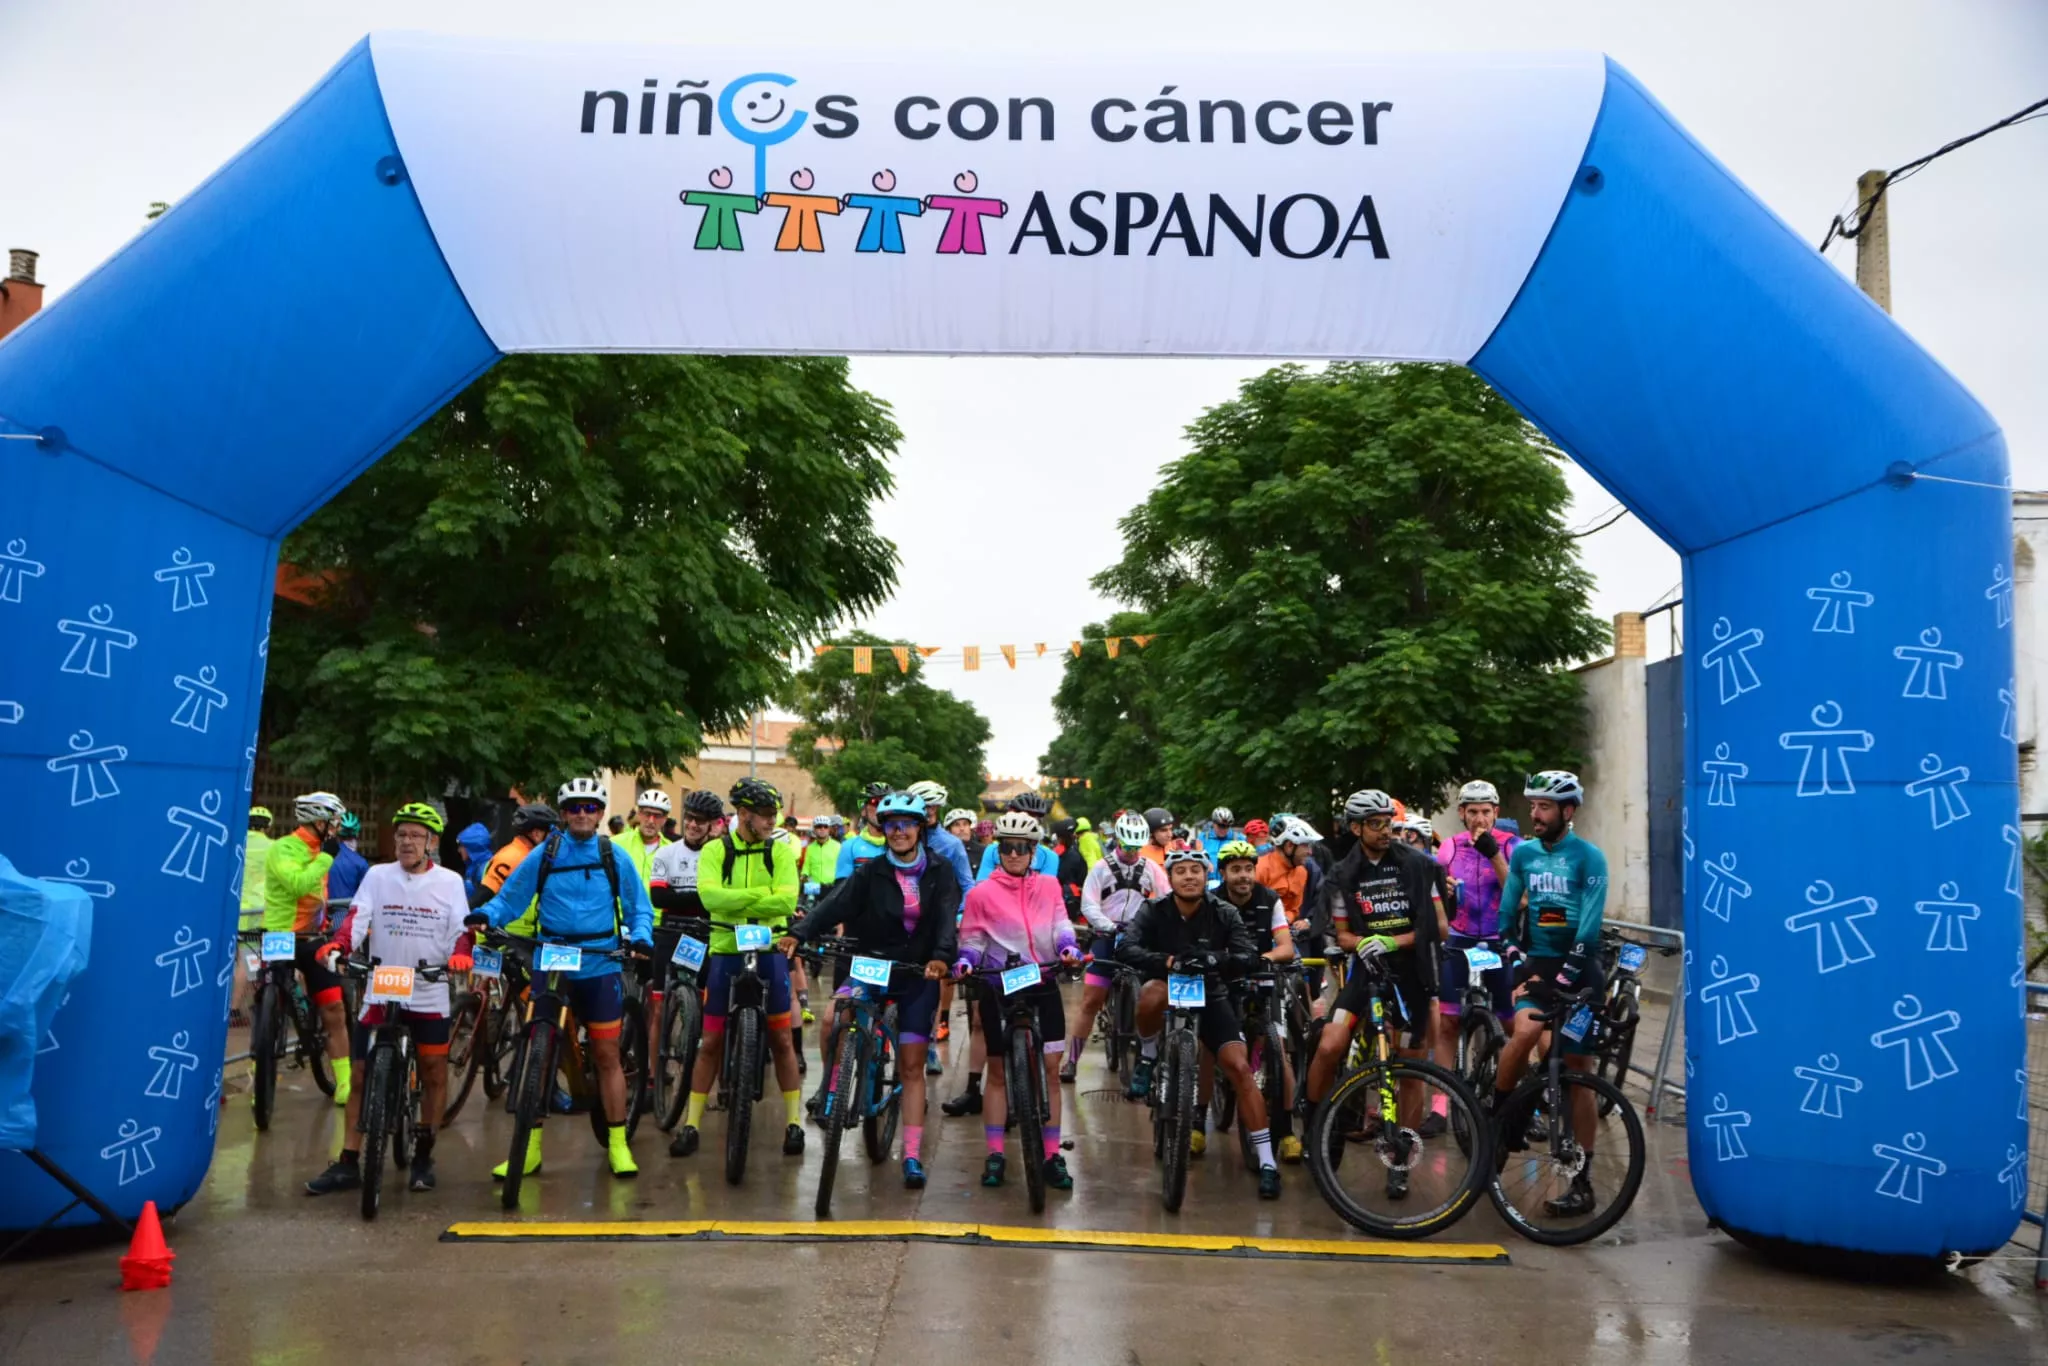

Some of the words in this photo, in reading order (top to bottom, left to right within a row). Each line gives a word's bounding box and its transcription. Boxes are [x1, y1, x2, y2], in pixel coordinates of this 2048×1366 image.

[893, 96, 1055, 141] con
[1090, 86, 1393, 146] cáncer
[1008, 191, 1391, 260] ASPANOA
[1361, 900, 1410, 914] BARON
[744, 930, 763, 940] 41
[678, 942, 705, 959] 377
[854, 963, 888, 979] 307
[377, 974, 411, 987] 1019
[1171, 982, 1200, 997] 271
